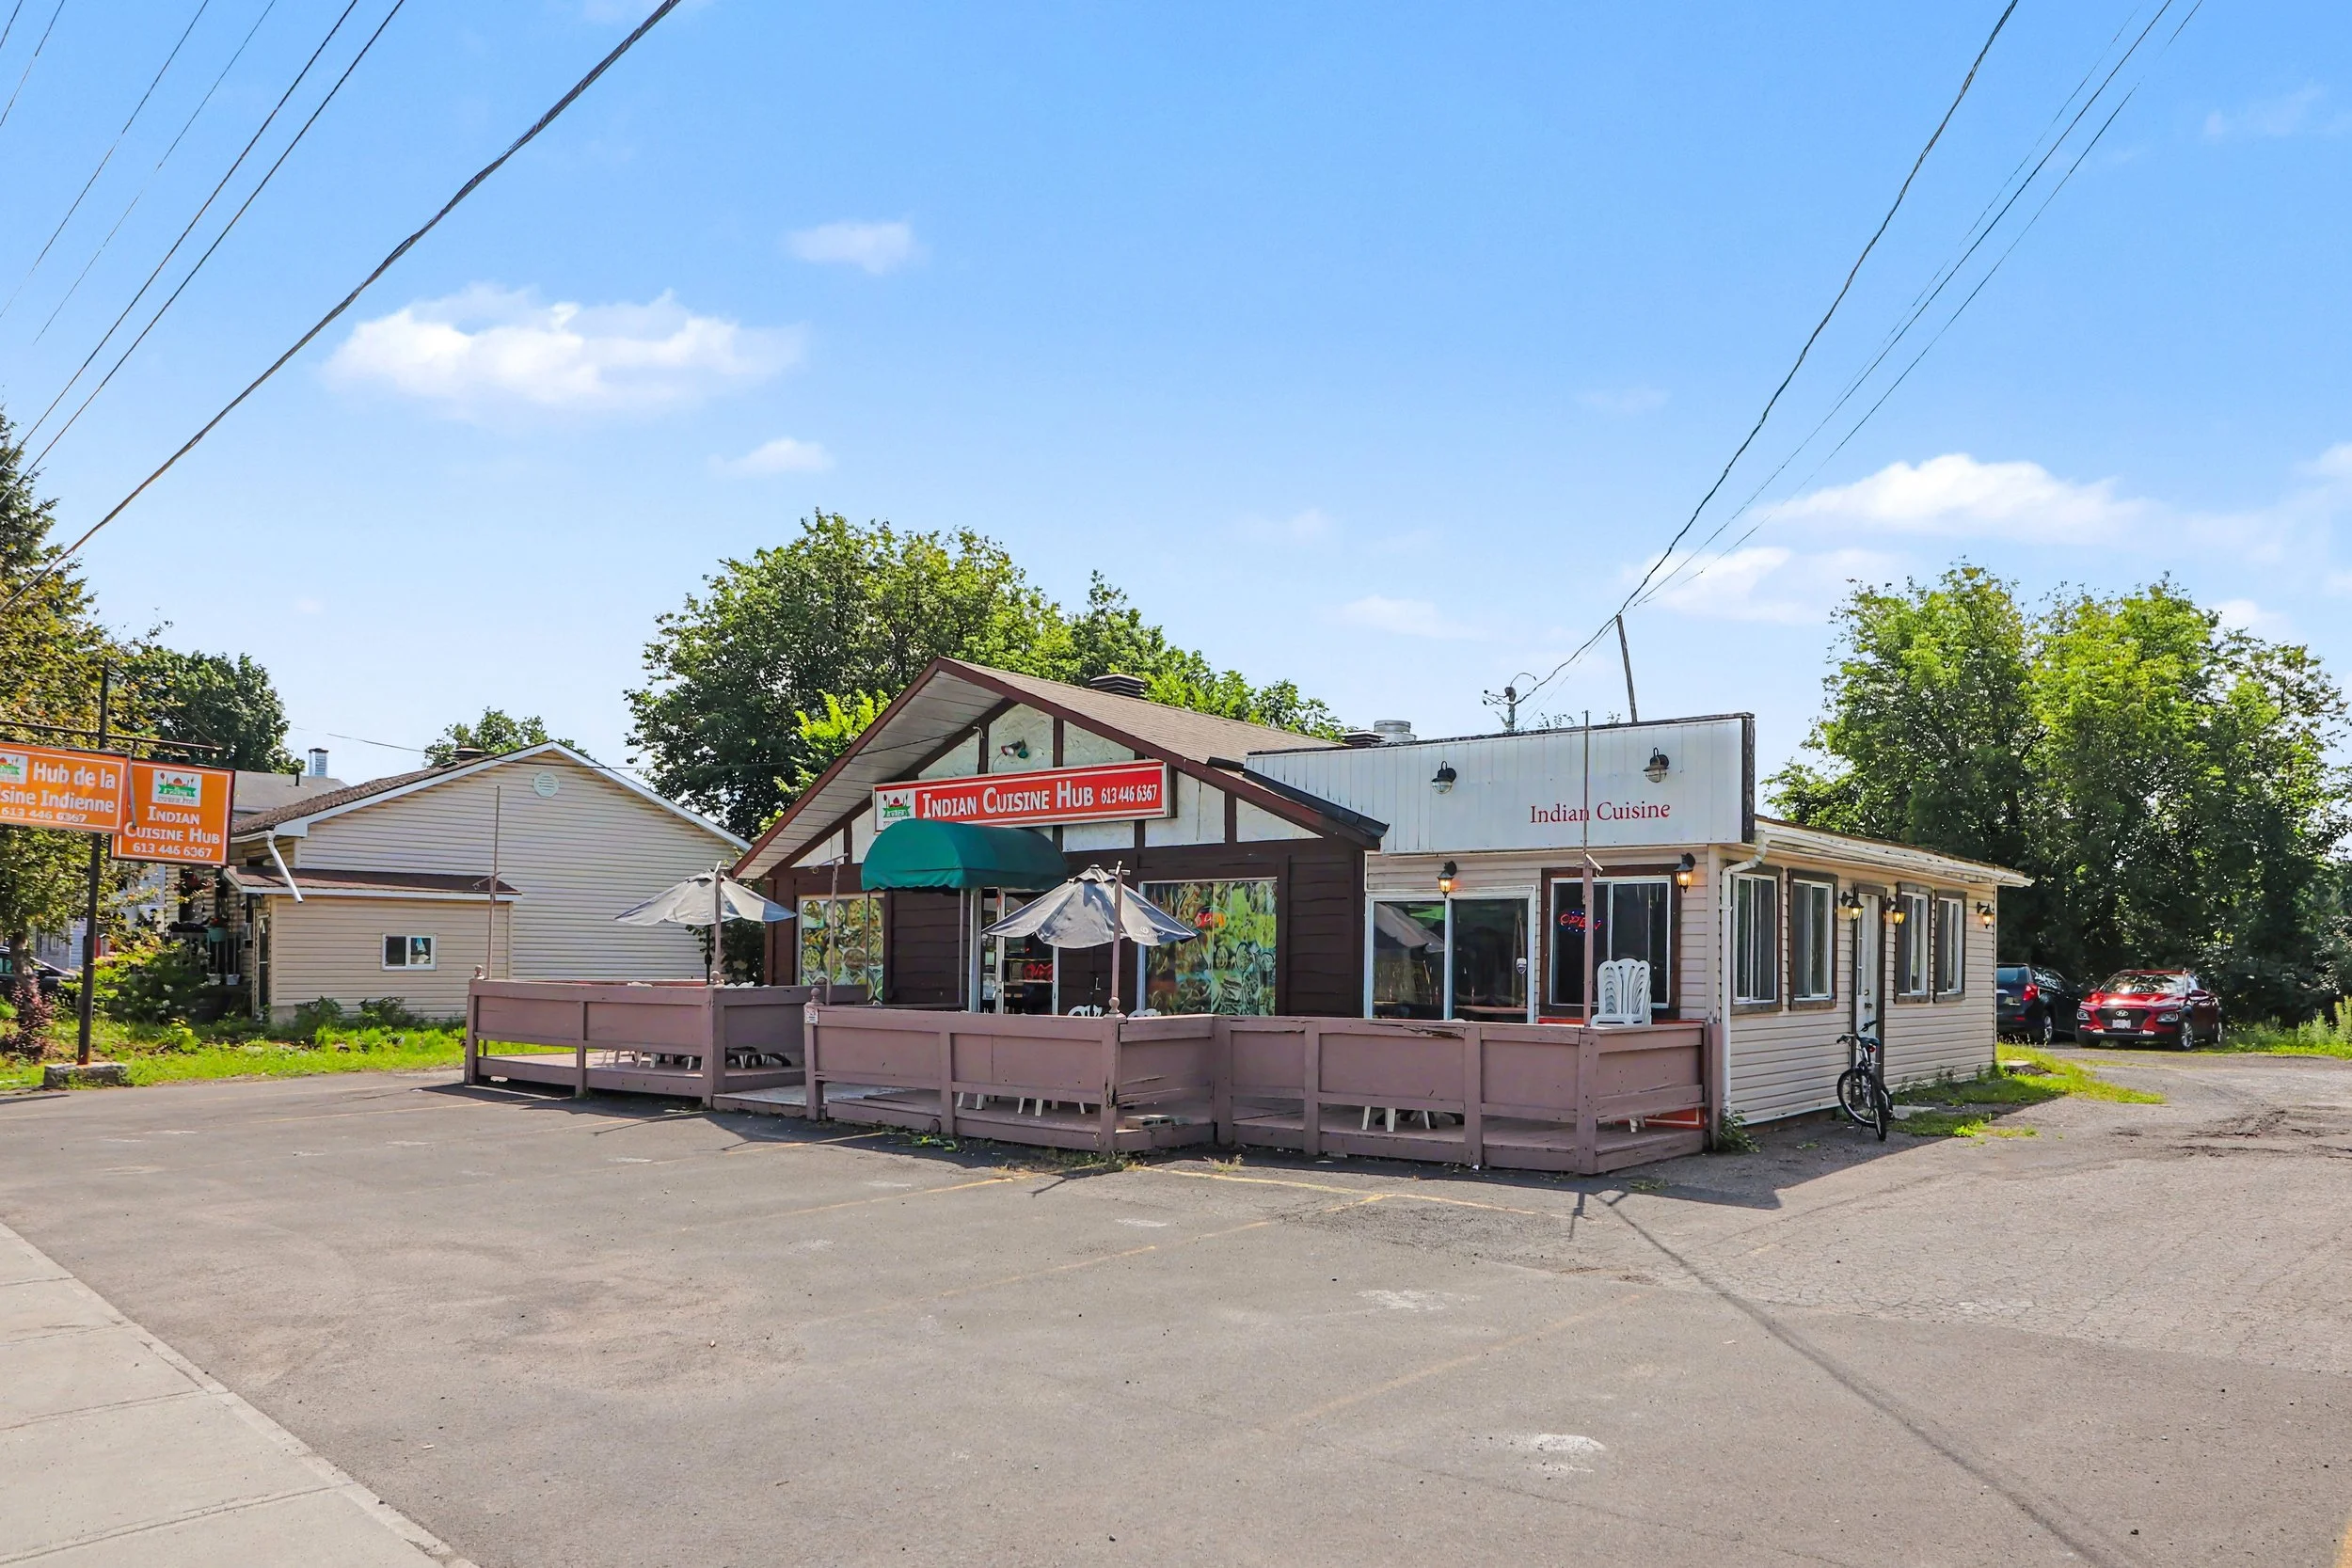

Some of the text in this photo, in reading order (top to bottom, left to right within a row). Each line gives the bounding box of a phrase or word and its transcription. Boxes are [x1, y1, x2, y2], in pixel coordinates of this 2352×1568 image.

[33, 761, 70, 784] Hub
[73, 767, 96, 787] de
[100, 768, 116, 790] la
[40, 789, 115, 814] Indienne
[922, 781, 1157, 818] INDIAN CUISINE HUB 613 446 6367
[1, 807, 87, 823] 613 446 6367
[148, 805, 199, 825] INDIAN
[1530, 800, 1671, 824] Indian Cuisine
[124, 821, 220, 845] CUISINE HUB
[133, 843, 213, 858] 613 446 6367
